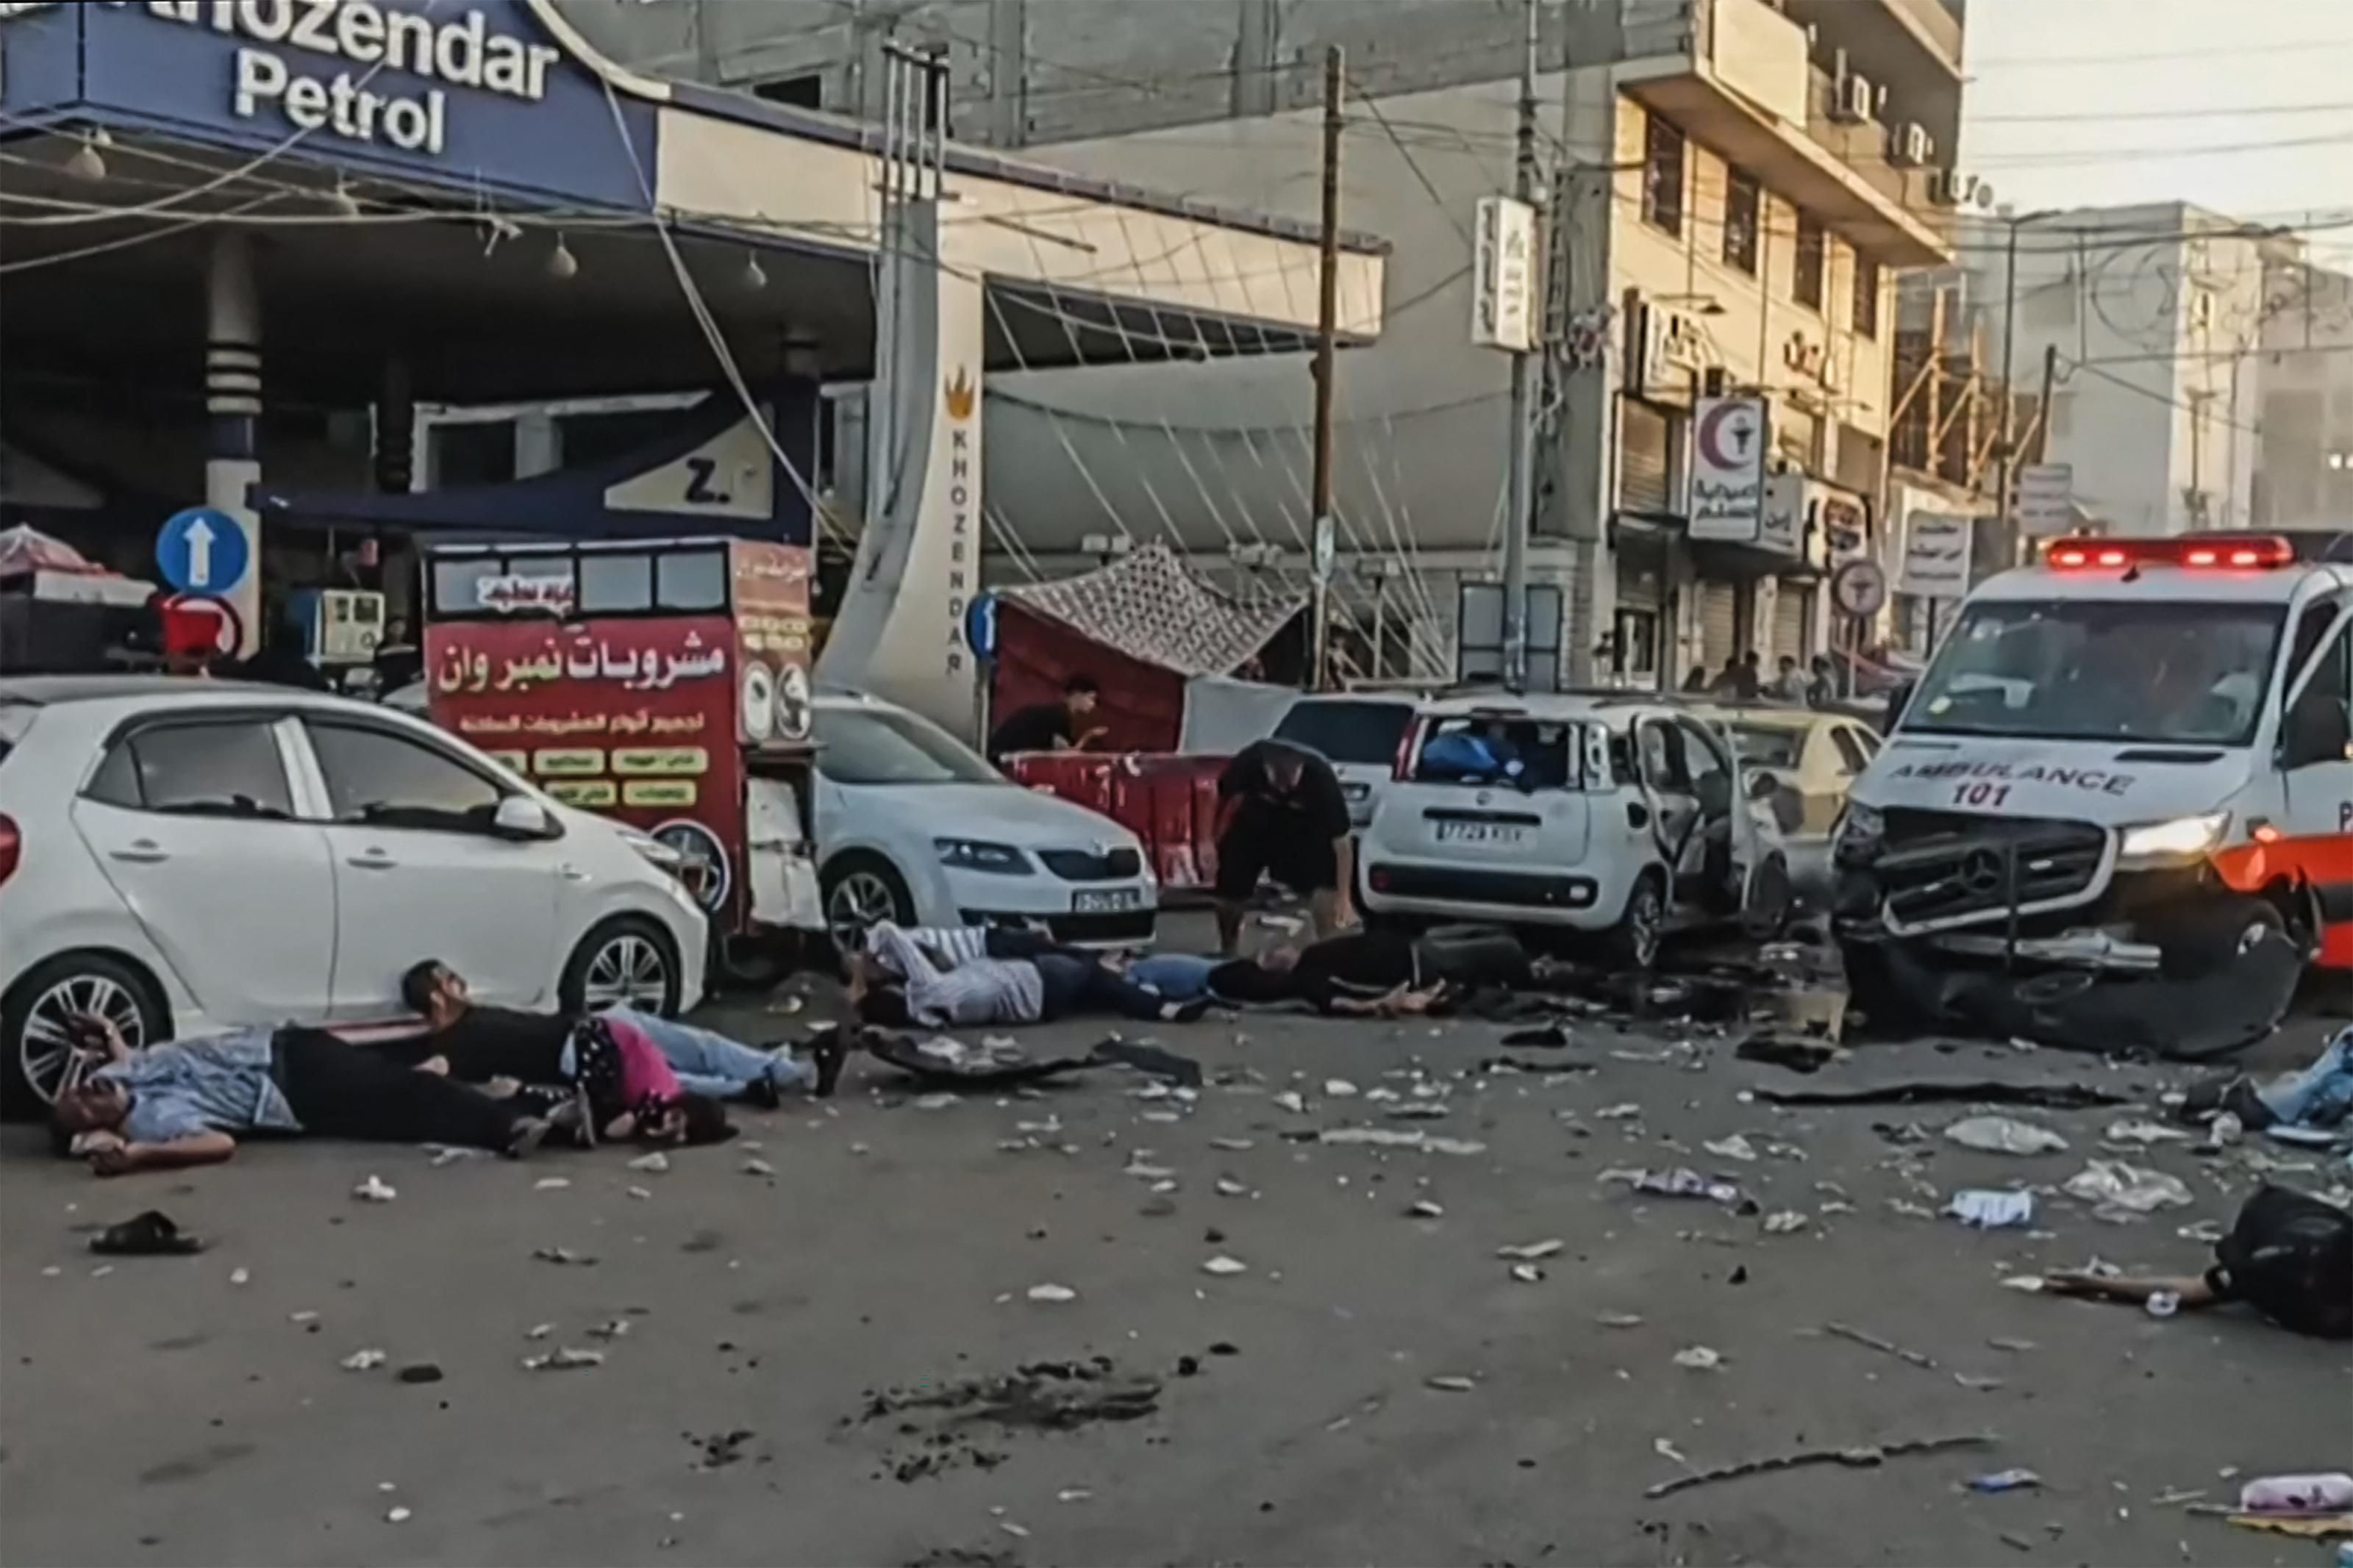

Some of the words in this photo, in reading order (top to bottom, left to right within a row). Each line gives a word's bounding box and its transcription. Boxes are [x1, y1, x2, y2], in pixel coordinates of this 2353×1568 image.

[103, 1, 560, 100] ozendar
[237, 47, 445, 154] Petrol
[946, 429, 967, 676] KHOZENDAR
[438, 644, 490, 692] وان
[567, 629, 726, 690] مشروبات
[1887, 762, 2137, 797] AMBULANCE
[1952, 782, 2012, 807] 101
